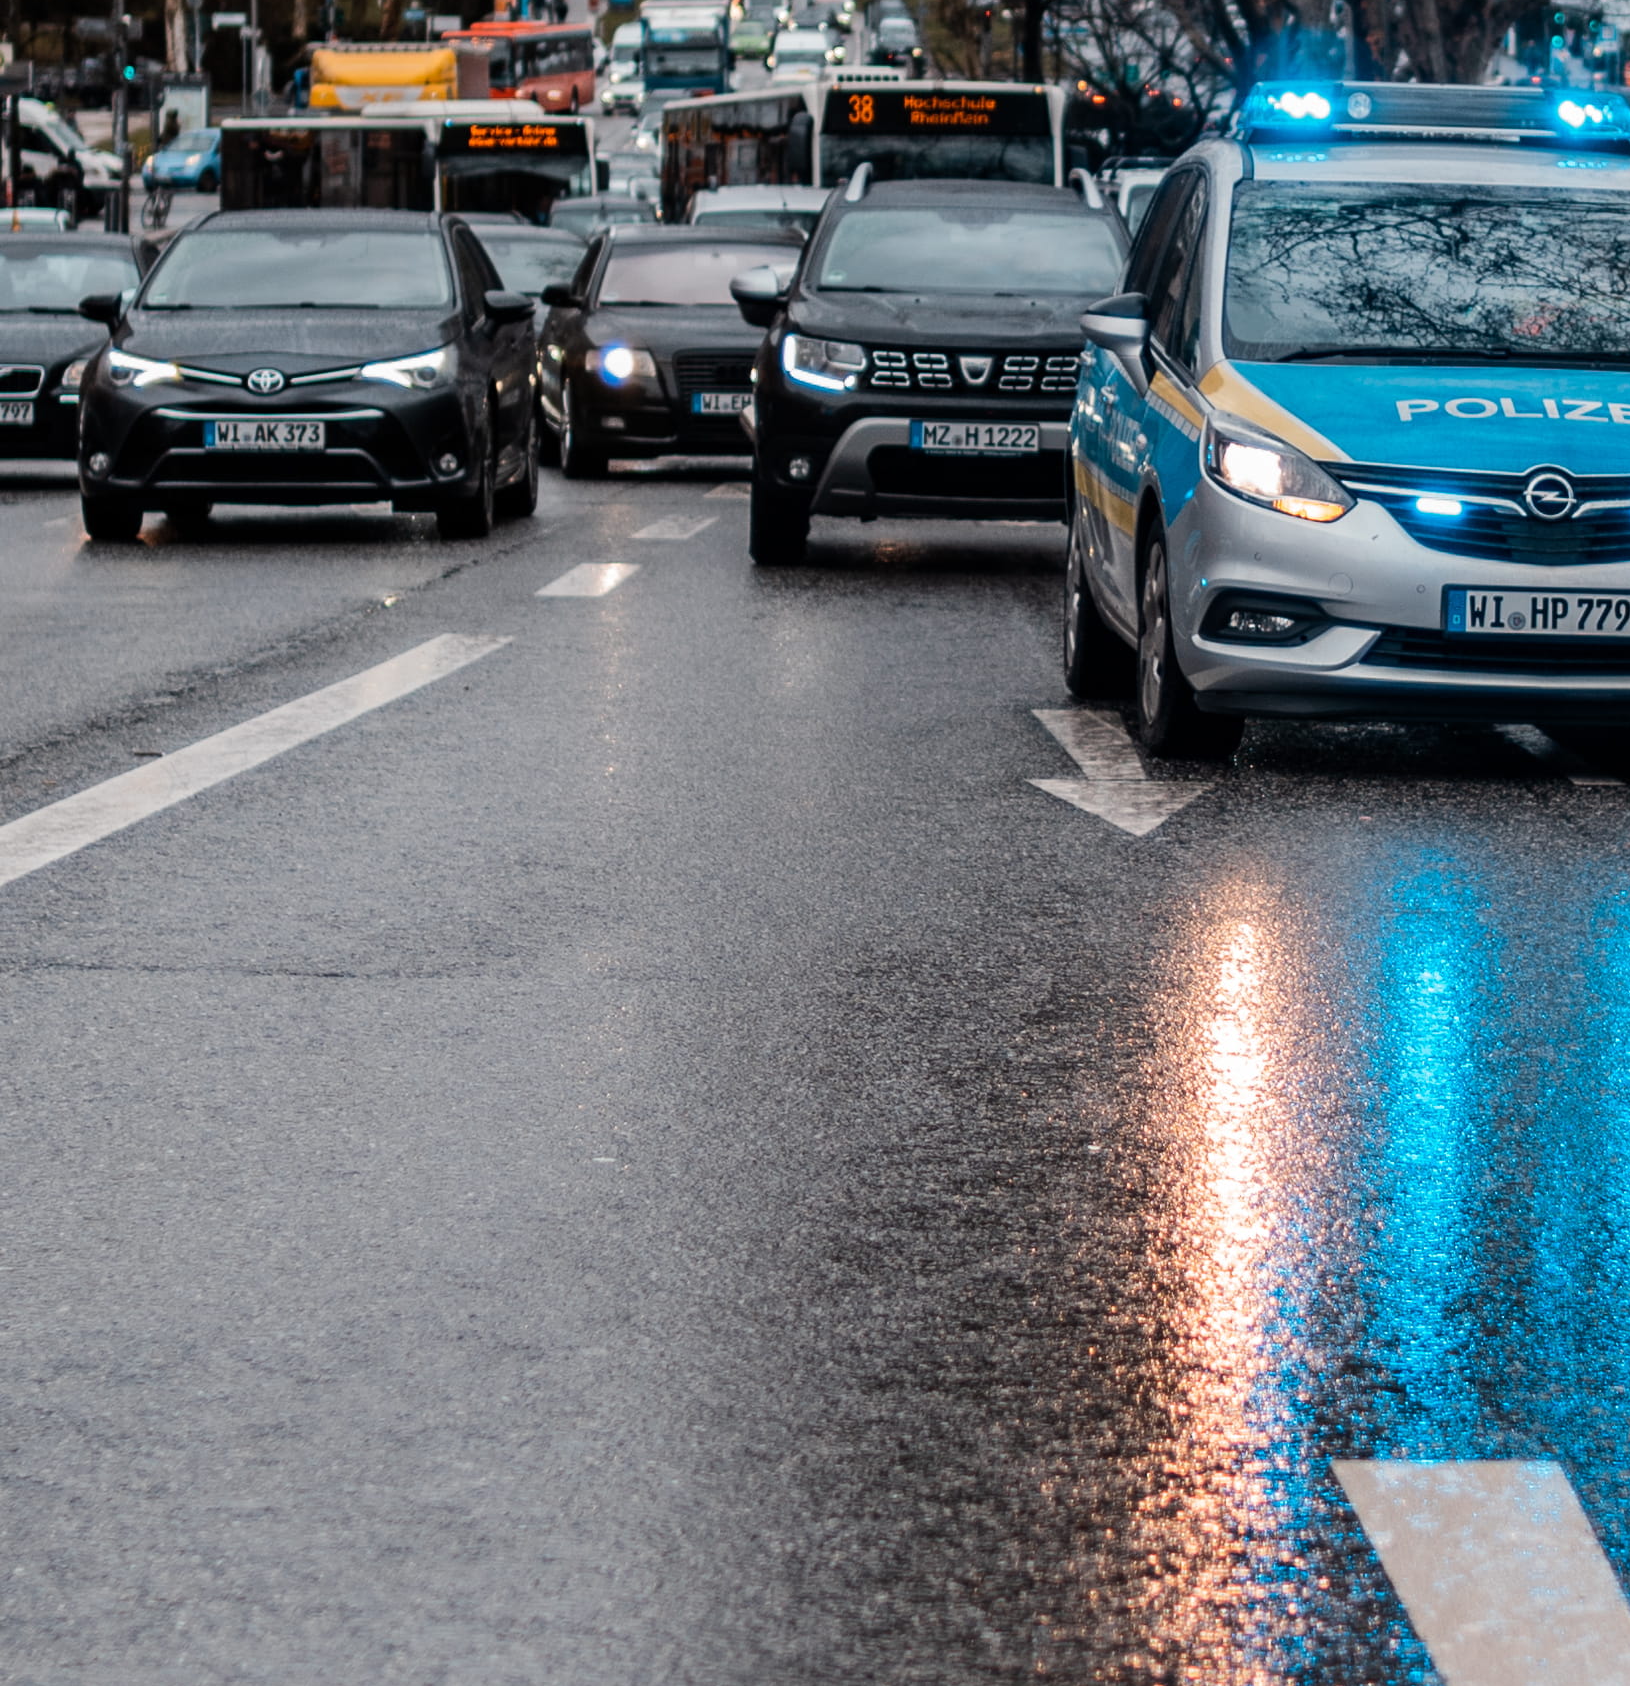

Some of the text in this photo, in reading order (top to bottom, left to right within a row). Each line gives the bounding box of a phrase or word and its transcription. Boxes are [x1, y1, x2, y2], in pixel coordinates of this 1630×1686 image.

[849, 94, 874, 124] 38
[904, 95, 996, 110] Hochschule
[217, 423, 320, 442] WI AK 373
[924, 425, 1036, 448] MZ H 1222
[1469, 595, 1505, 628] WI
[1531, 597, 1569, 629] HP
